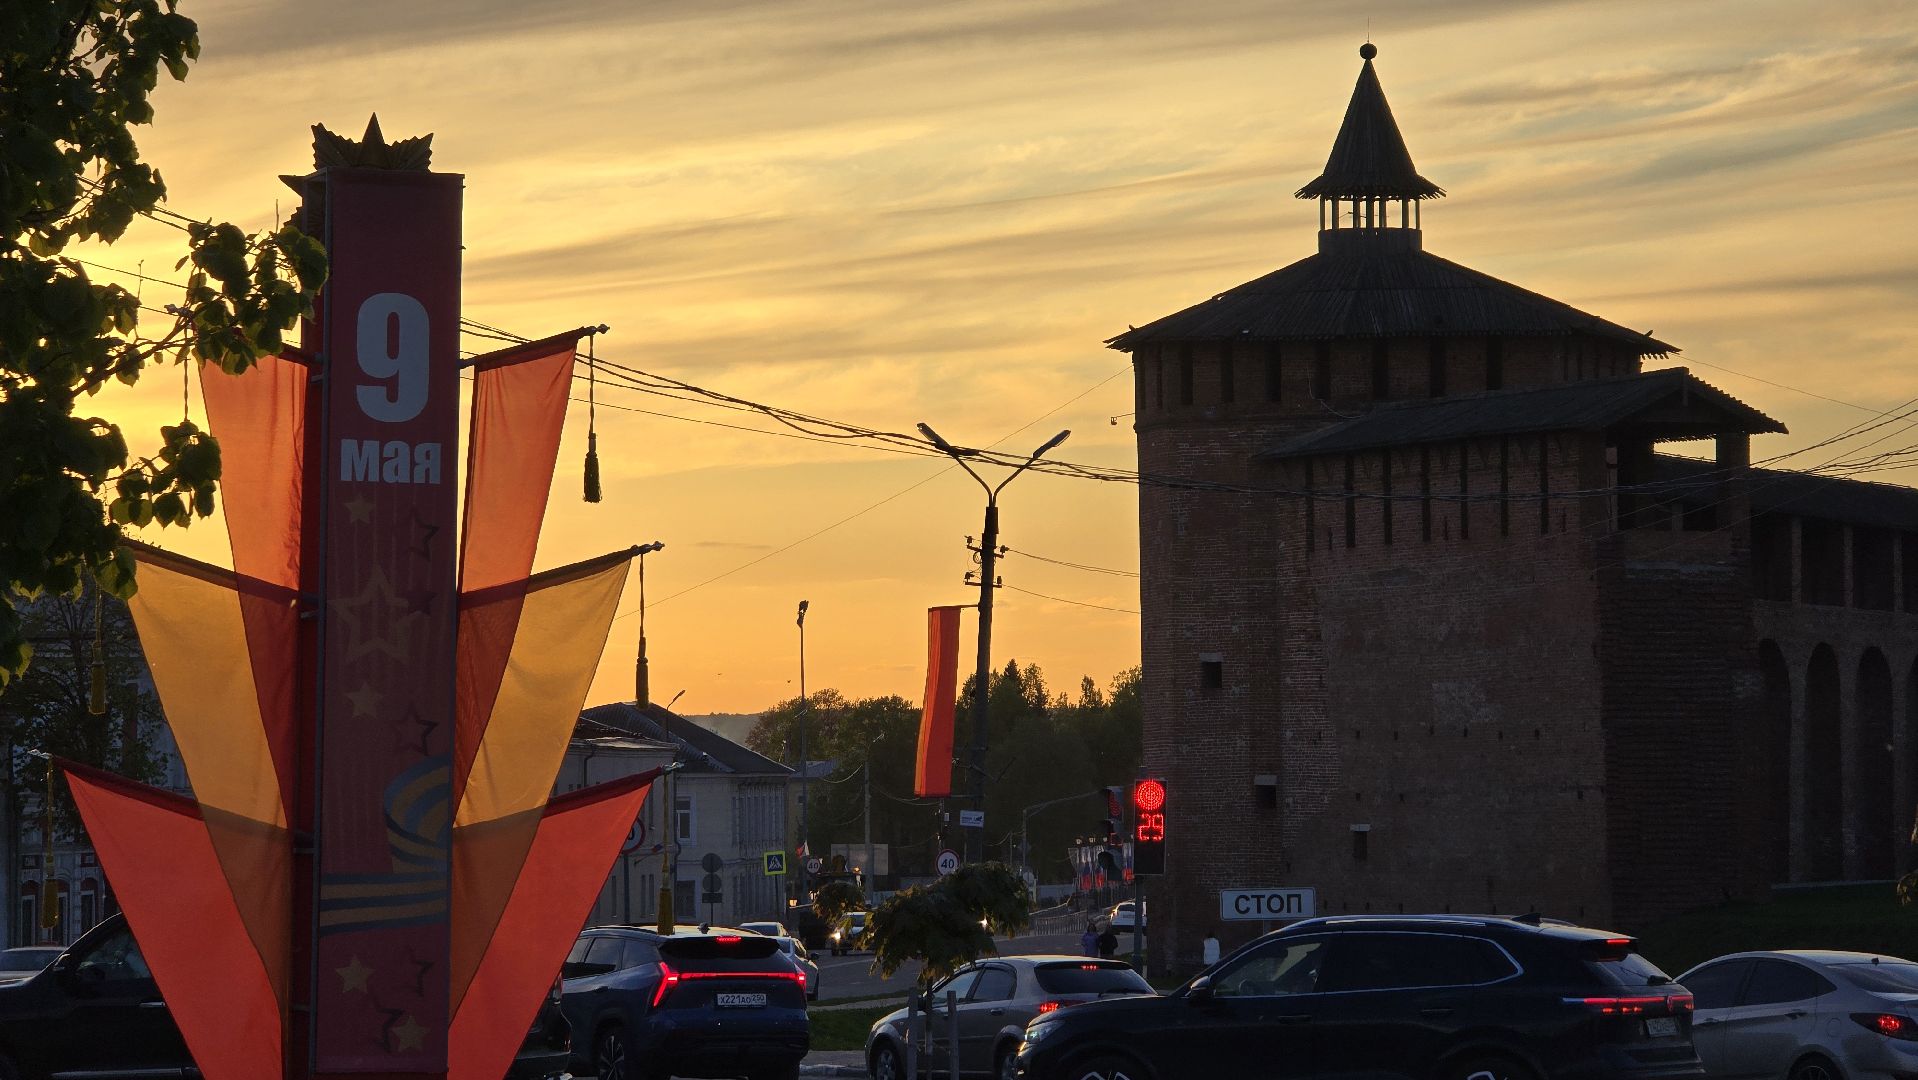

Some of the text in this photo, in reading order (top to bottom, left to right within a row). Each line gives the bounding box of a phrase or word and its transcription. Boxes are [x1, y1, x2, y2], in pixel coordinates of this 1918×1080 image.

[356, 292, 430, 423] 9
[340, 438, 442, 485] мая
[1138, 813, 1164, 841] 29
[940, 858, 955, 869] 40
[1234, 893, 1302, 915] СТОП
